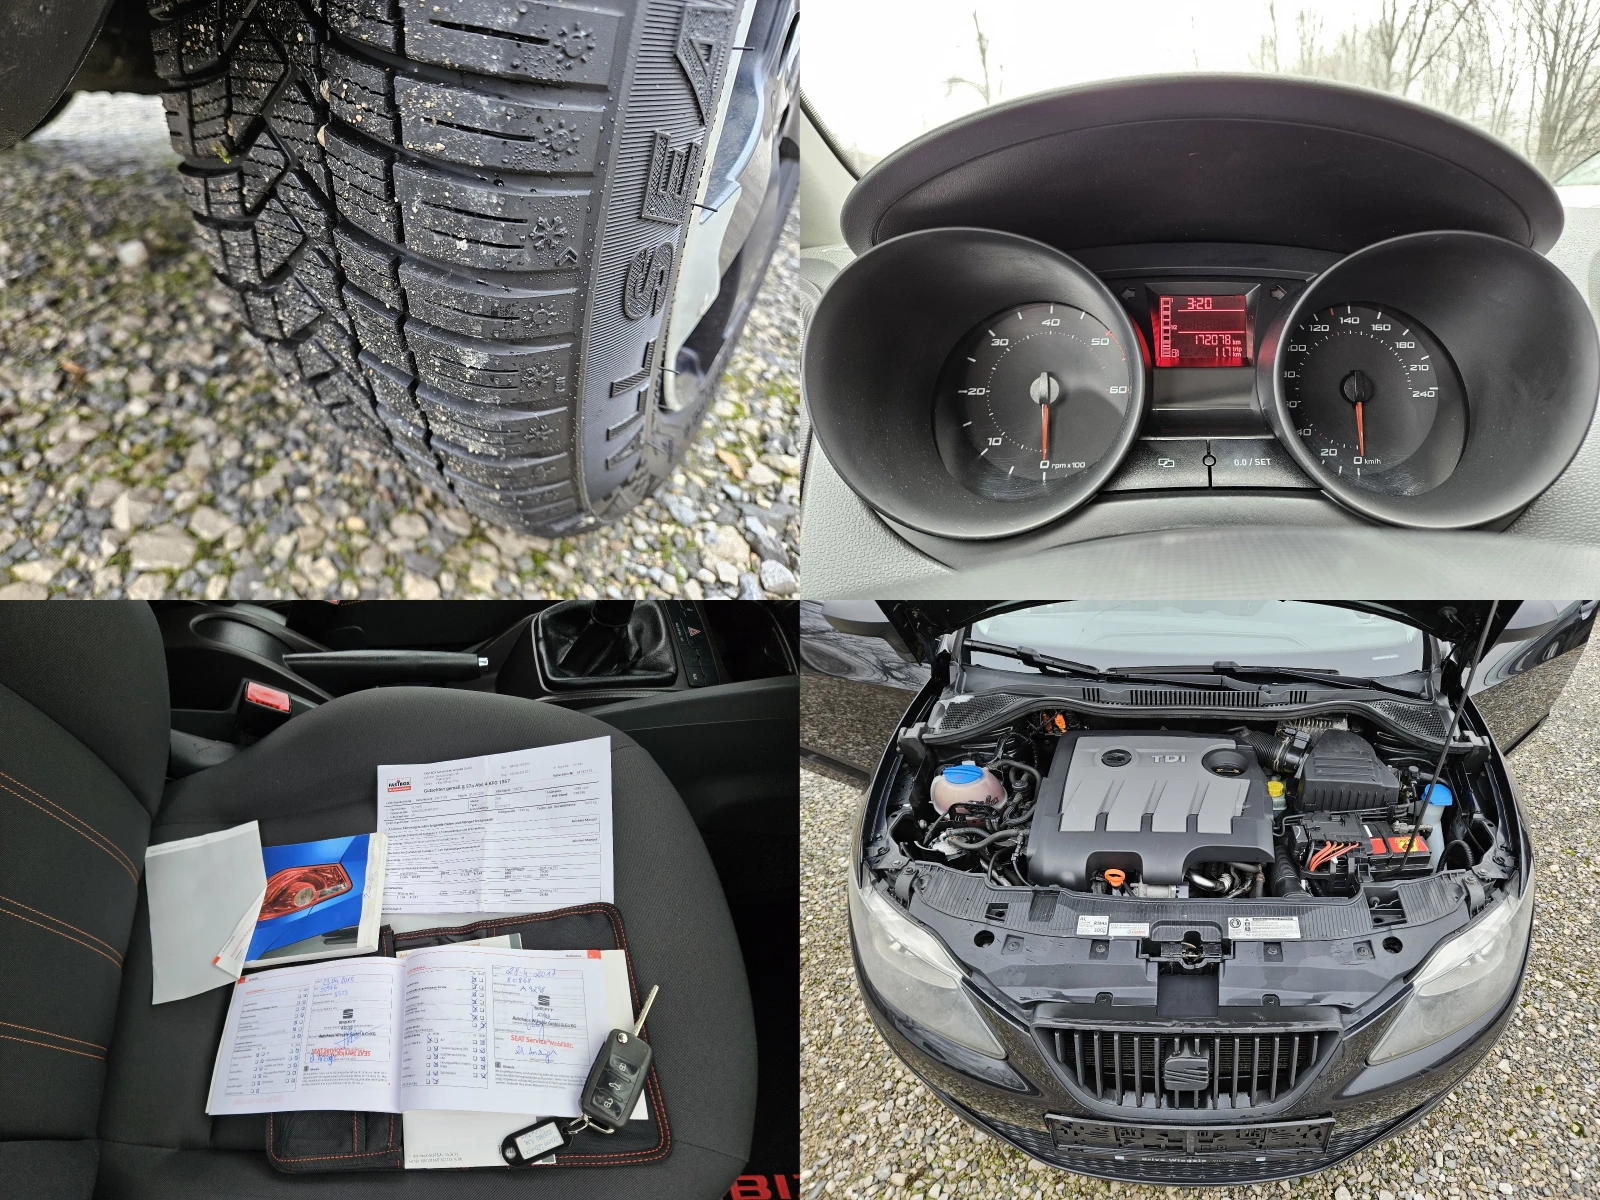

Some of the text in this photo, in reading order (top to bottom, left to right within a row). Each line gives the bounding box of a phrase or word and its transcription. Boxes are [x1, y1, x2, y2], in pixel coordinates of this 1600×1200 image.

[1187, 297, 1213, 310] 3:20
[1041, 318, 1060, 327] 40
[1339, 316, 1360, 324] 140
[1309, 324, 1330, 332] 120
[990, 338, 1009, 346] 30
[1090, 337, 1109, 346] 50
[1195, 334, 1231, 346] 172078
[1394, 341, 1415, 349] 180
[1409, 364, 1429, 372] 210
[967, 388, 986, 396] 20
[1109, 386, 1127, 394] 60
[1412, 390, 1435, 398] 240
[1286, 400, 1298, 408] 0
[987, 437, 1002, 446] 10
[1320, 448, 1338, 457] 20
[1039, 460, 1049, 469] 0
[1234, 458, 1247, 466] 0.0
[1254, 458, 1271, 466] SET
[1353, 456, 1382, 466] 0 km/h
[1151, 755, 1186, 763] TDI
[510, 1034, 524, 1043] SEAT
